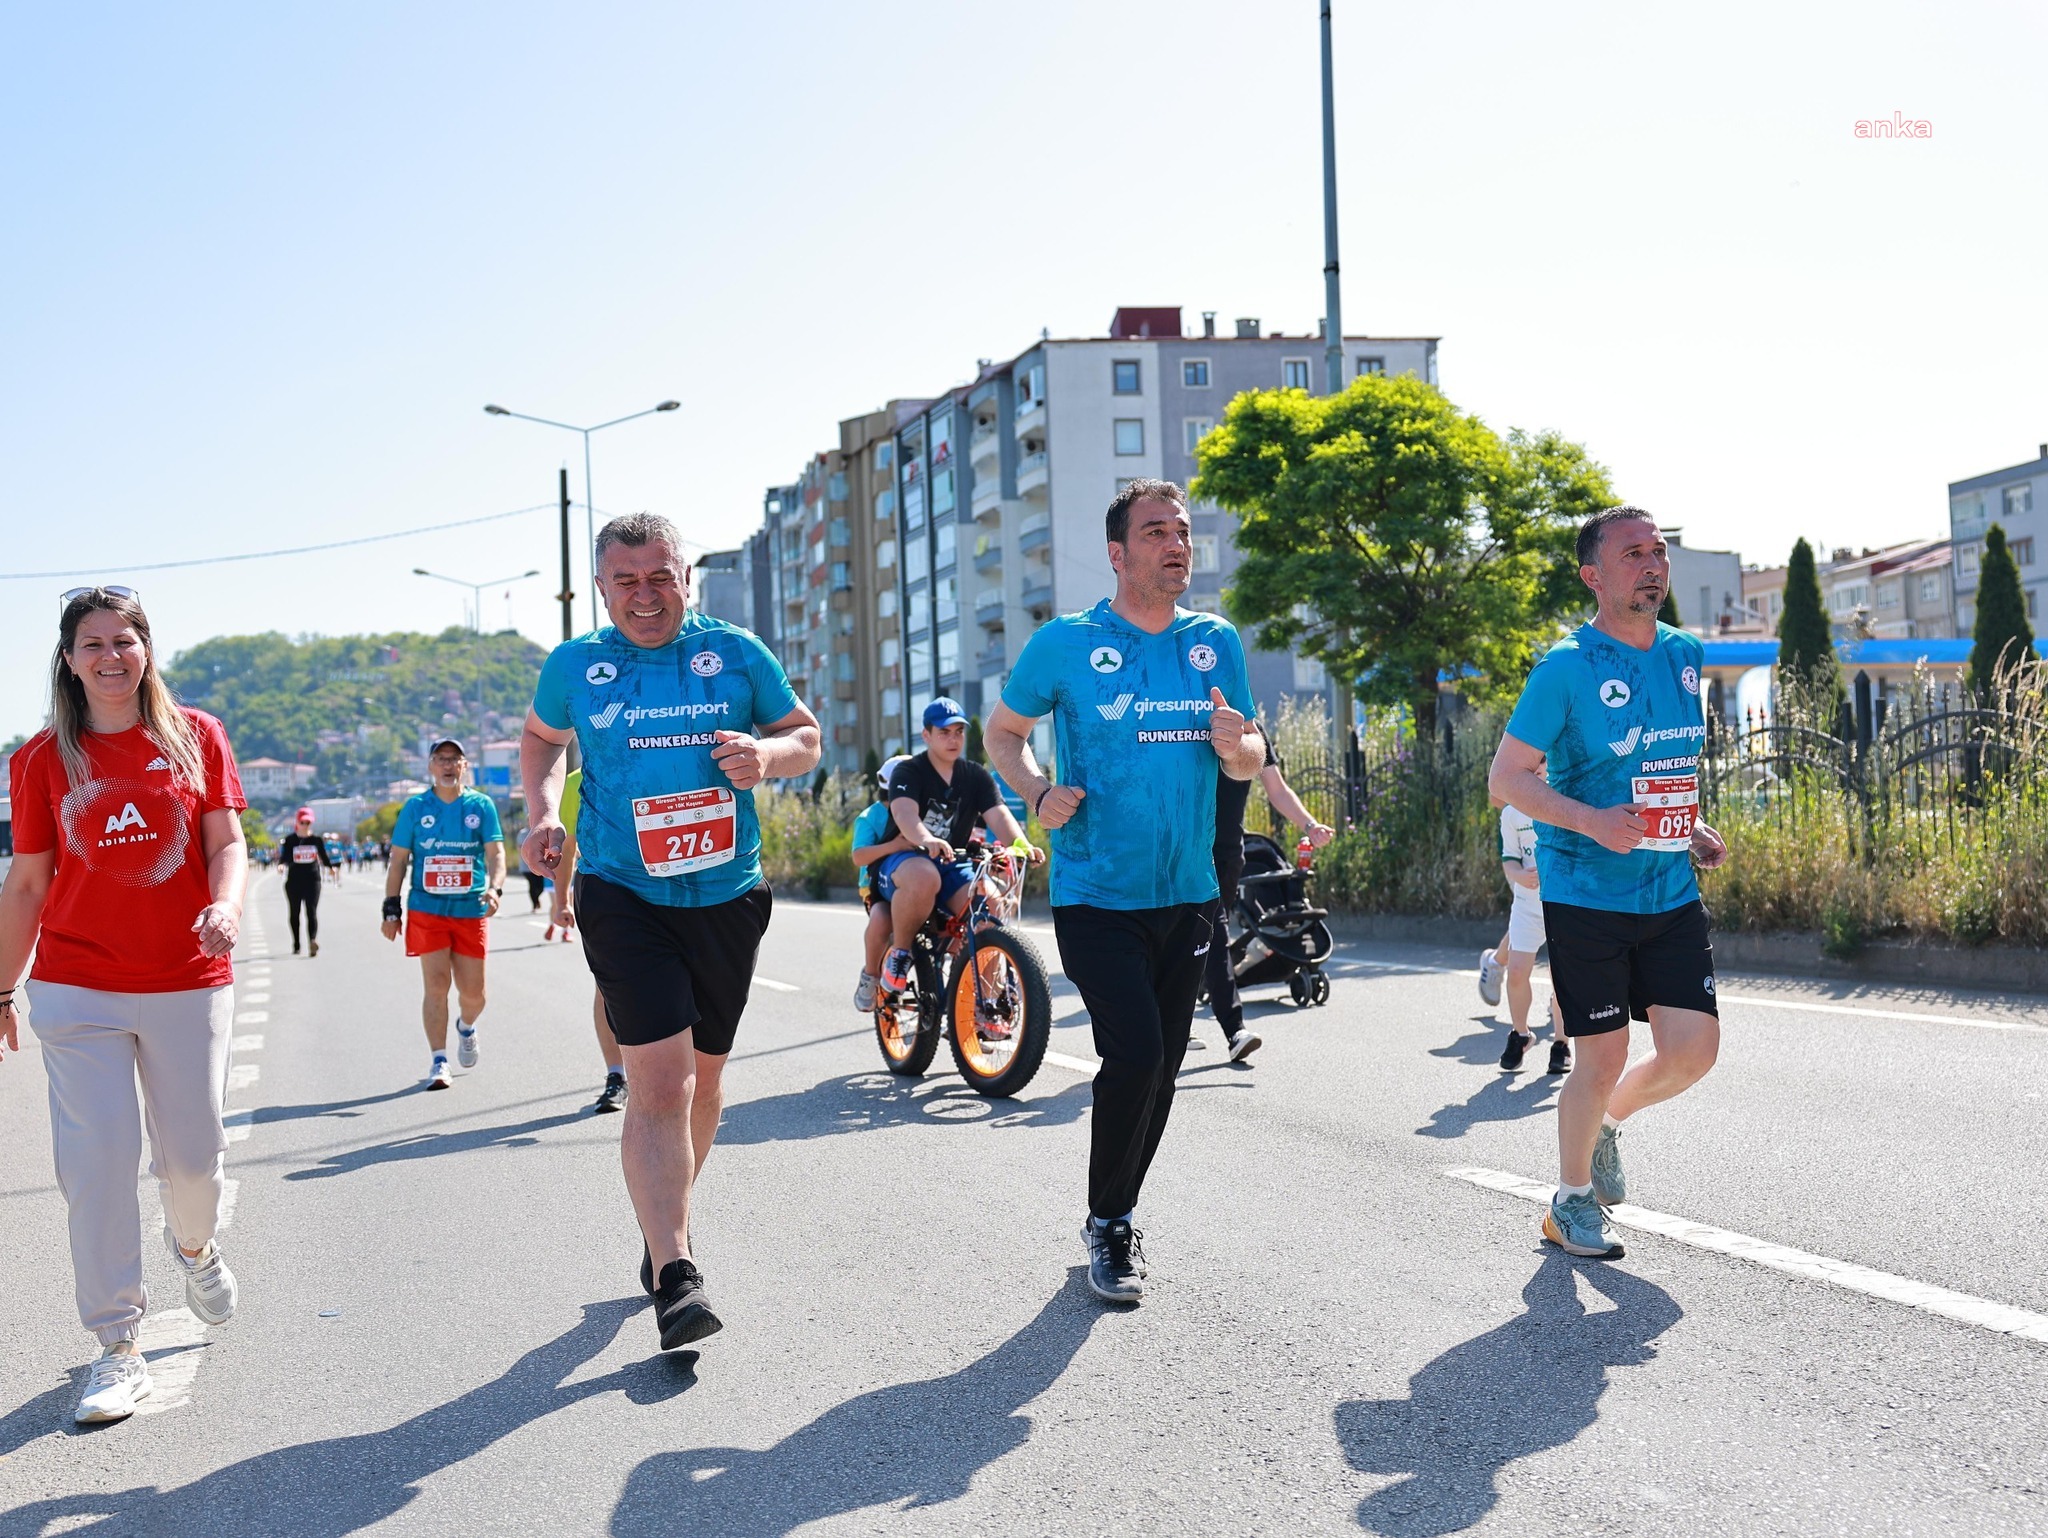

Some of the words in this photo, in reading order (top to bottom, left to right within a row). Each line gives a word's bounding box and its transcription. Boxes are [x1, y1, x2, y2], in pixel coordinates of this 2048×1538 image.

[623, 702, 729, 727] giresunport
[1134, 697, 1214, 720] giresunpor
[628, 732, 721, 749] RUNKERASU
[1138, 730, 1212, 743] RUNKERASU
[1642, 725, 1705, 751] giresunpo
[145, 763, 170, 771] adida
[1659, 814, 1692, 838] 095
[98, 836, 126, 848] ADIM
[130, 832, 158, 843] ADIM
[666, 830, 714, 860] 276
[436, 876, 462, 887] 033
